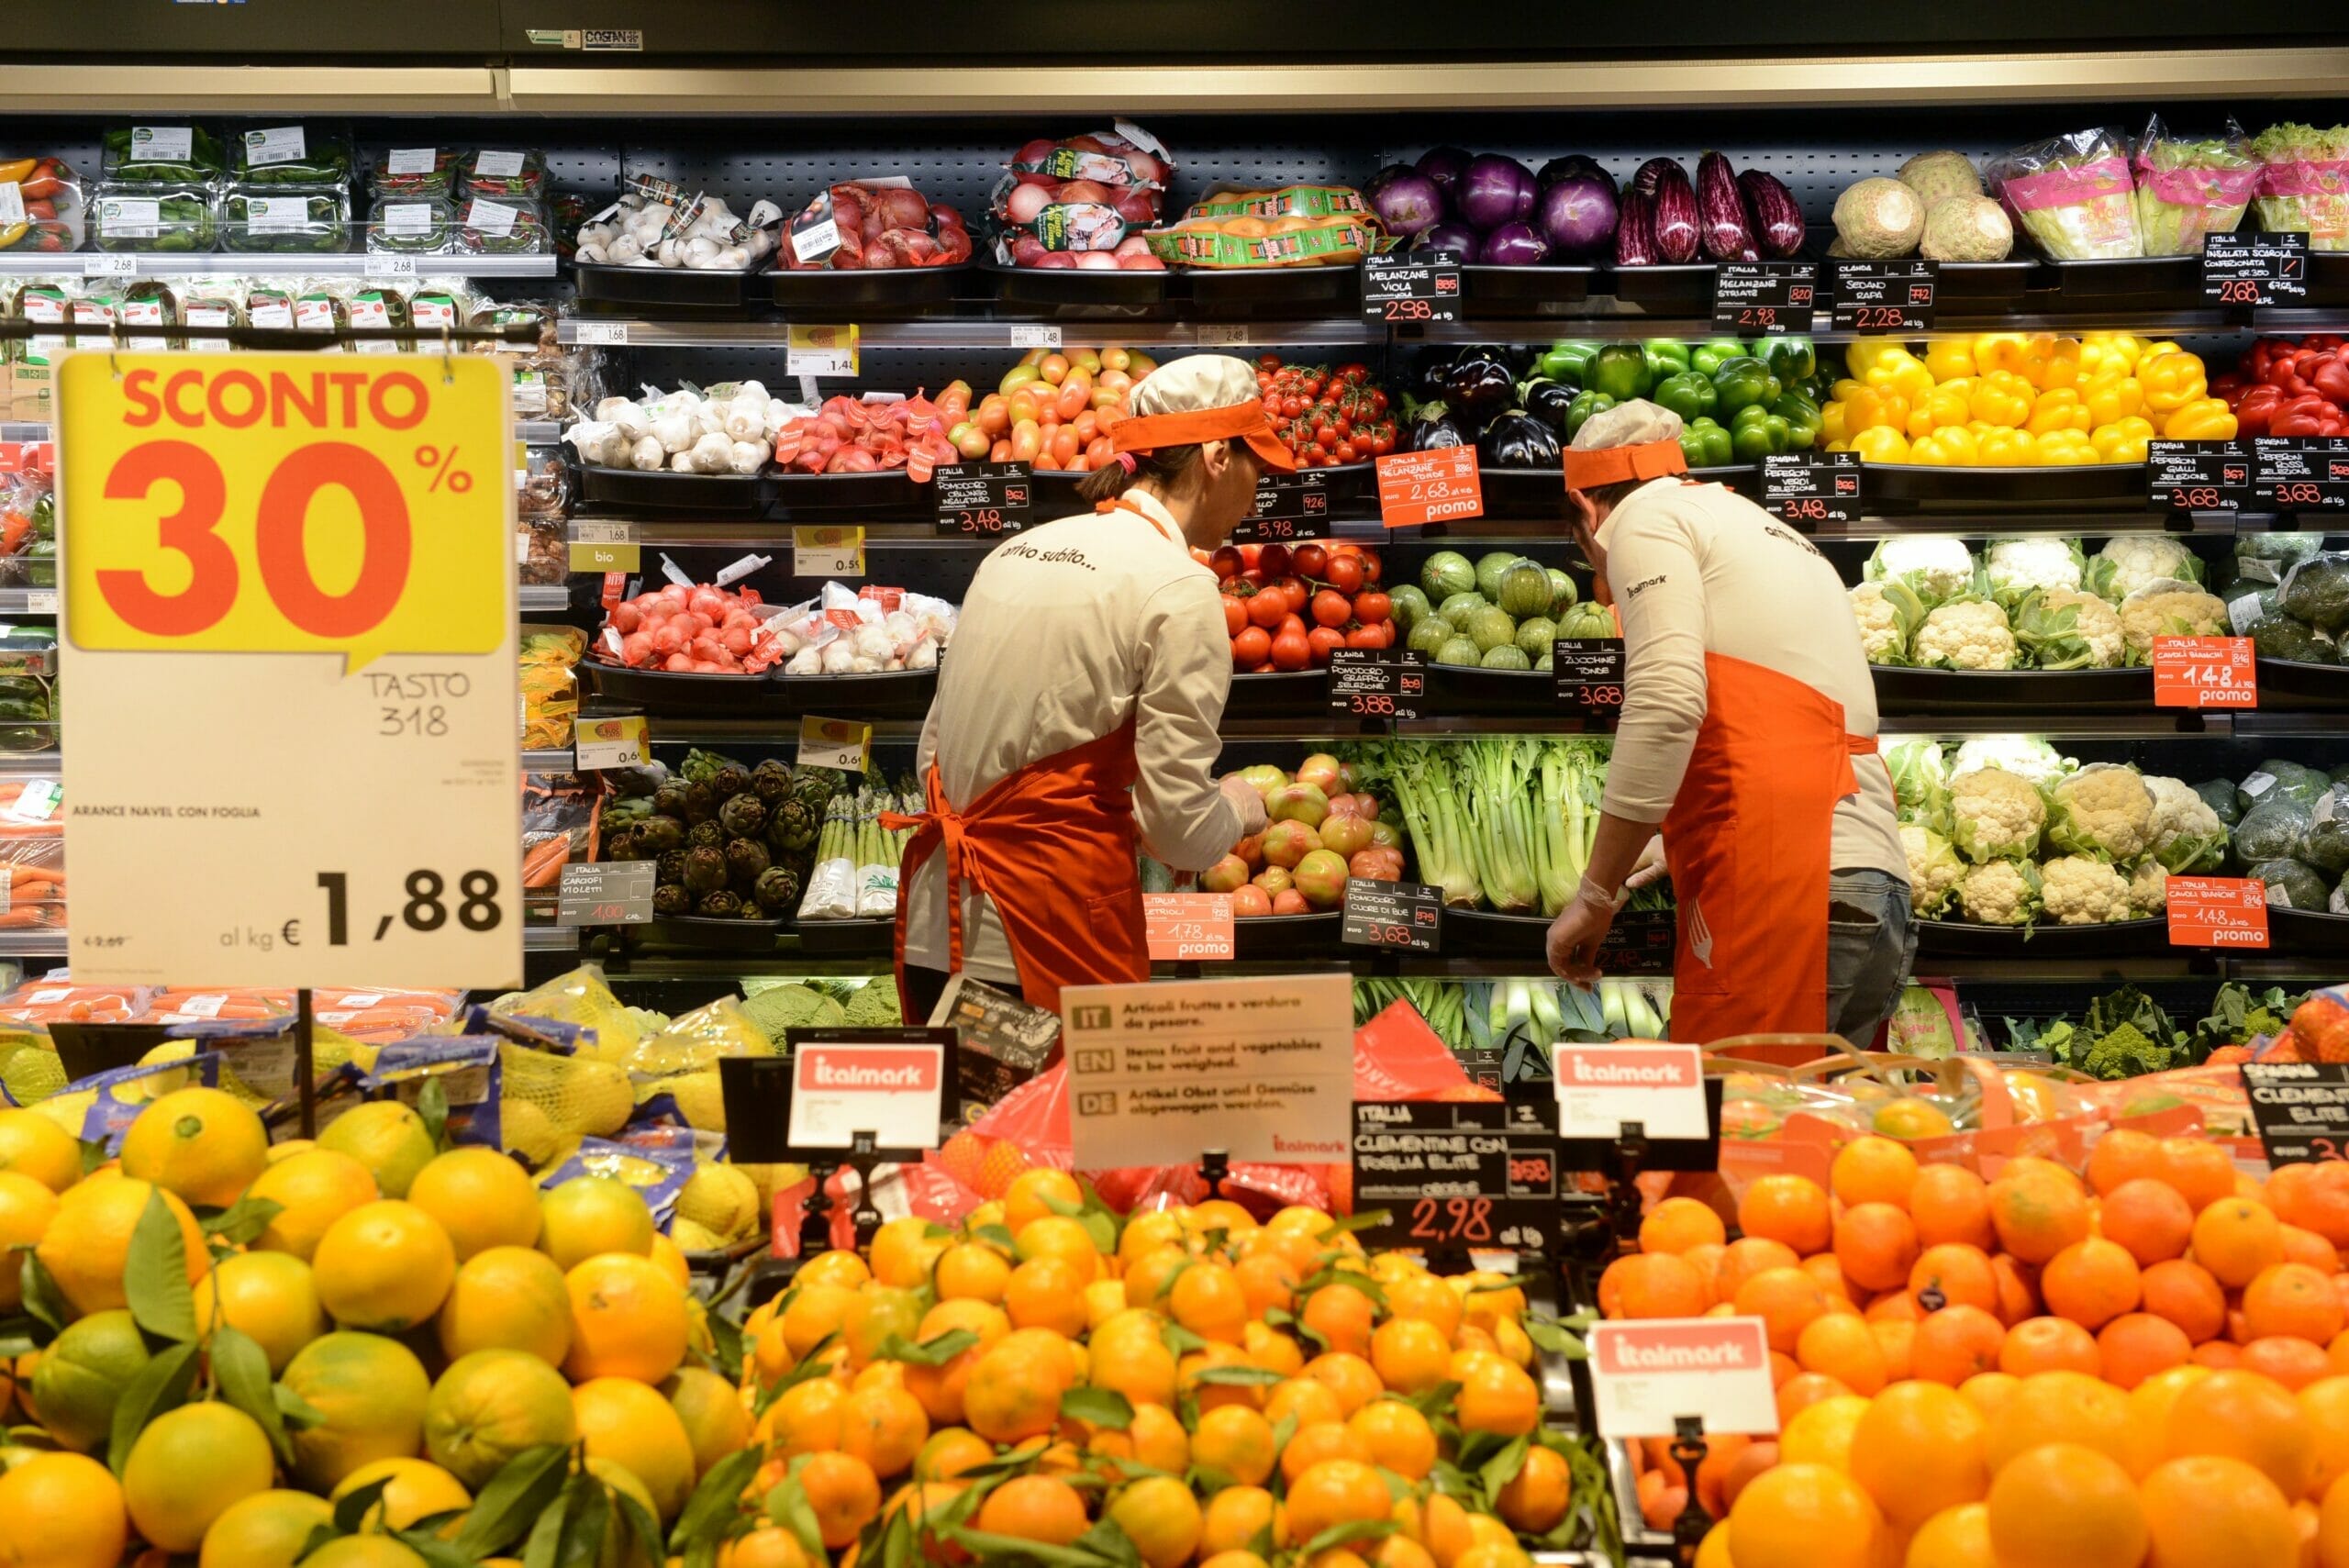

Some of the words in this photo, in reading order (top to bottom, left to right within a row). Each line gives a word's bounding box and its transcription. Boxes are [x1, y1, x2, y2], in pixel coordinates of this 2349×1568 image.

[585, 31, 627, 42] COSTAN
[1368, 256, 1394, 264] ITALIA
[2207, 250, 2249, 258] INSALATA
[2252, 250, 2291, 258] SCAROLA
[1839, 265, 1872, 273] OLANDA
[2204, 259, 2266, 267] CONFEZIONATA
[1369, 271, 1429, 281] MELANZANE
[1720, 279, 1776, 288] MELANZANE
[1382, 282, 1411, 291] VIOLA
[1718, 288, 1758, 297] STRIATE
[1845, 280, 1887, 290] SEDANO
[2221, 281, 2259, 303] 2,68
[1855, 291, 1883, 300] RAPA
[1385, 300, 1431, 320] 2,98
[1738, 308, 1776, 327] 2,98
[1856, 308, 1904, 328] 2,28
[123, 370, 429, 429] SCONTO
[1390, 457, 1417, 466] ITALIA
[1766, 454, 1799, 463] SPAGNA
[2151, 457, 2196, 465] PEPERONI
[2257, 452, 2302, 461] PEPERONI
[1380, 463, 1433, 477] MELANZANE
[1414, 470, 1445, 480] TONDE
[1765, 469, 1810, 477] PEPERONI
[937, 482, 986, 490] POMODORO
[1410, 482, 1450, 501] 2,68
[1768, 484, 1817, 493] SELEZIONE
[2277, 484, 2321, 503] 3,68
[1305, 497, 1325, 508] 926
[2173, 488, 2219, 507] 3,68
[1427, 500, 1477, 521] promo
[1785, 499, 1827, 518] 3,48
[960, 509, 1002, 532] 3,48
[1258, 521, 1293, 538] 5,98
[95, 439, 412, 638] 30
[596, 550, 614, 562] bio
[1564, 656, 1616, 664] ZUCCHINE
[1331, 665, 1383, 675] POMODORO
[2183, 665, 2232, 688] 1,48
[362, 672, 471, 699] TASTO
[1337, 682, 1385, 690] SELEZIONE
[1580, 686, 1622, 705] 3,68
[2199, 690, 2252, 706] promo
[1352, 695, 1394, 714] 3,88
[379, 706, 450, 736] 318
[72, 806, 125, 817] ARANCE
[130, 806, 173, 817] NAVEL
[177, 806, 207, 817] CON
[212, 806, 261, 817] FOGLIA
[563, 877, 602, 885] CARCIOFI
[1349, 893, 1396, 905] POMODORO
[219, 927, 239, 947] al
[248, 927, 273, 951] kg
[281, 919, 301, 946] €
[317, 870, 503, 947] 1,88
[1351, 904, 1379, 913] CUORE
[2195, 908, 2228, 925] 1,48
[1368, 924, 1410, 944] 3,68
[2213, 929, 2264, 945] promo
[1179, 943, 1229, 958] promo
[1122, 1001, 1175, 1016] Articoli
[1180, 997, 1221, 1011] frutta
[1226, 1000, 1235, 1008] e
[1241, 995, 1300, 1008] verdura
[1124, 1017, 1143, 1029] da
[1149, 1017, 1204, 1031] pesare.
[1125, 1047, 1165, 1058] Items
[1171, 1043, 1202, 1056] fruit
[1207, 1042, 1236, 1054] and
[1241, 1039, 1321, 1055] vegetables
[815, 1055, 922, 1084] italmark
[1126, 1062, 1141, 1072] to
[1147, 1060, 1164, 1071] be
[1171, 1057, 1239, 1072] weighed.
[1573, 1055, 1682, 1082] italmark
[1129, 1088, 1177, 1100] Artikel
[1183, 1086, 1217, 1098] Obst
[1223, 1084, 1251, 1096] und
[1256, 1083, 1317, 1095] Gemüse
[1358, 1105, 1412, 1123] ITALIA
[1273, 1134, 1345, 1153] italmark
[1353, 1134, 1468, 1153] CLEMENTINE
[1469, 1136, 1508, 1153] CON
[1358, 1155, 1424, 1172] FOGLIA
[1427, 1153, 1481, 1171] ELITE
[1409, 1195, 1493, 1243] 2,98
[1615, 1334, 1743, 1366] italmark
